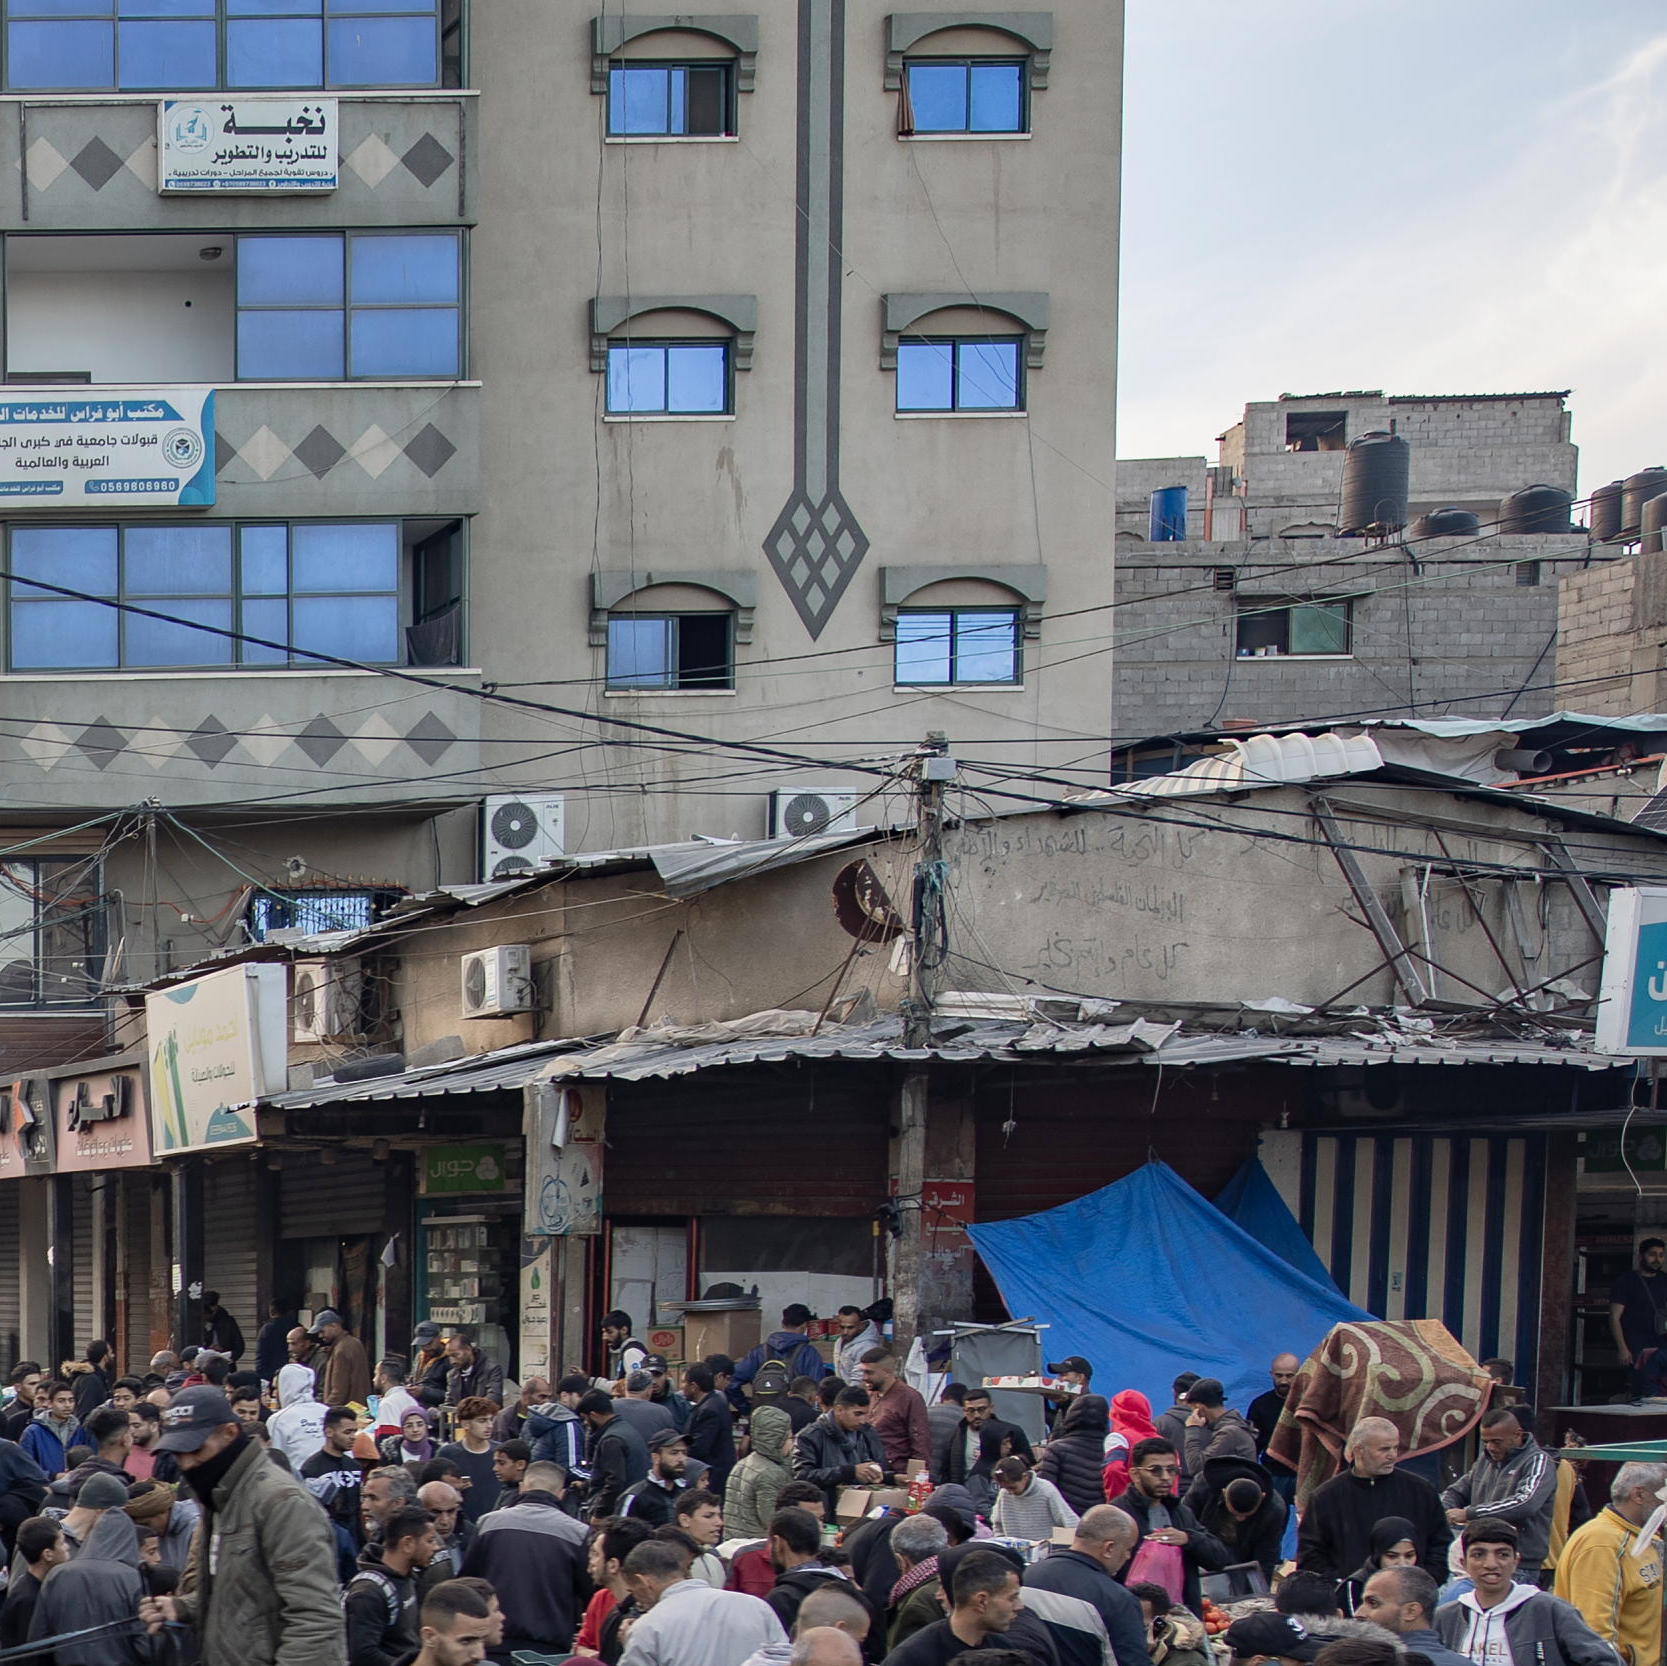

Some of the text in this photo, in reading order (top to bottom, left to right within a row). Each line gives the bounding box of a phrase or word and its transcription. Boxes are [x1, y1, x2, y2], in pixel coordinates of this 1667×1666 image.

[220, 104, 326, 144] نخبة
[211, 144, 329, 165] للتدريب والتطوير
[13, 406, 66, 422] للخدمات
[70, 405, 104, 423] فراس
[106, 402, 124, 420] أبو
[127, 403, 164, 418] مكتب
[20, 436, 51, 450] كبرى
[76, 435, 117, 449] جامعية
[120, 434, 158, 449] قبولات
[15, 456, 110, 470] العربية والعالمية
[430, 1159, 476, 1178] جوال
